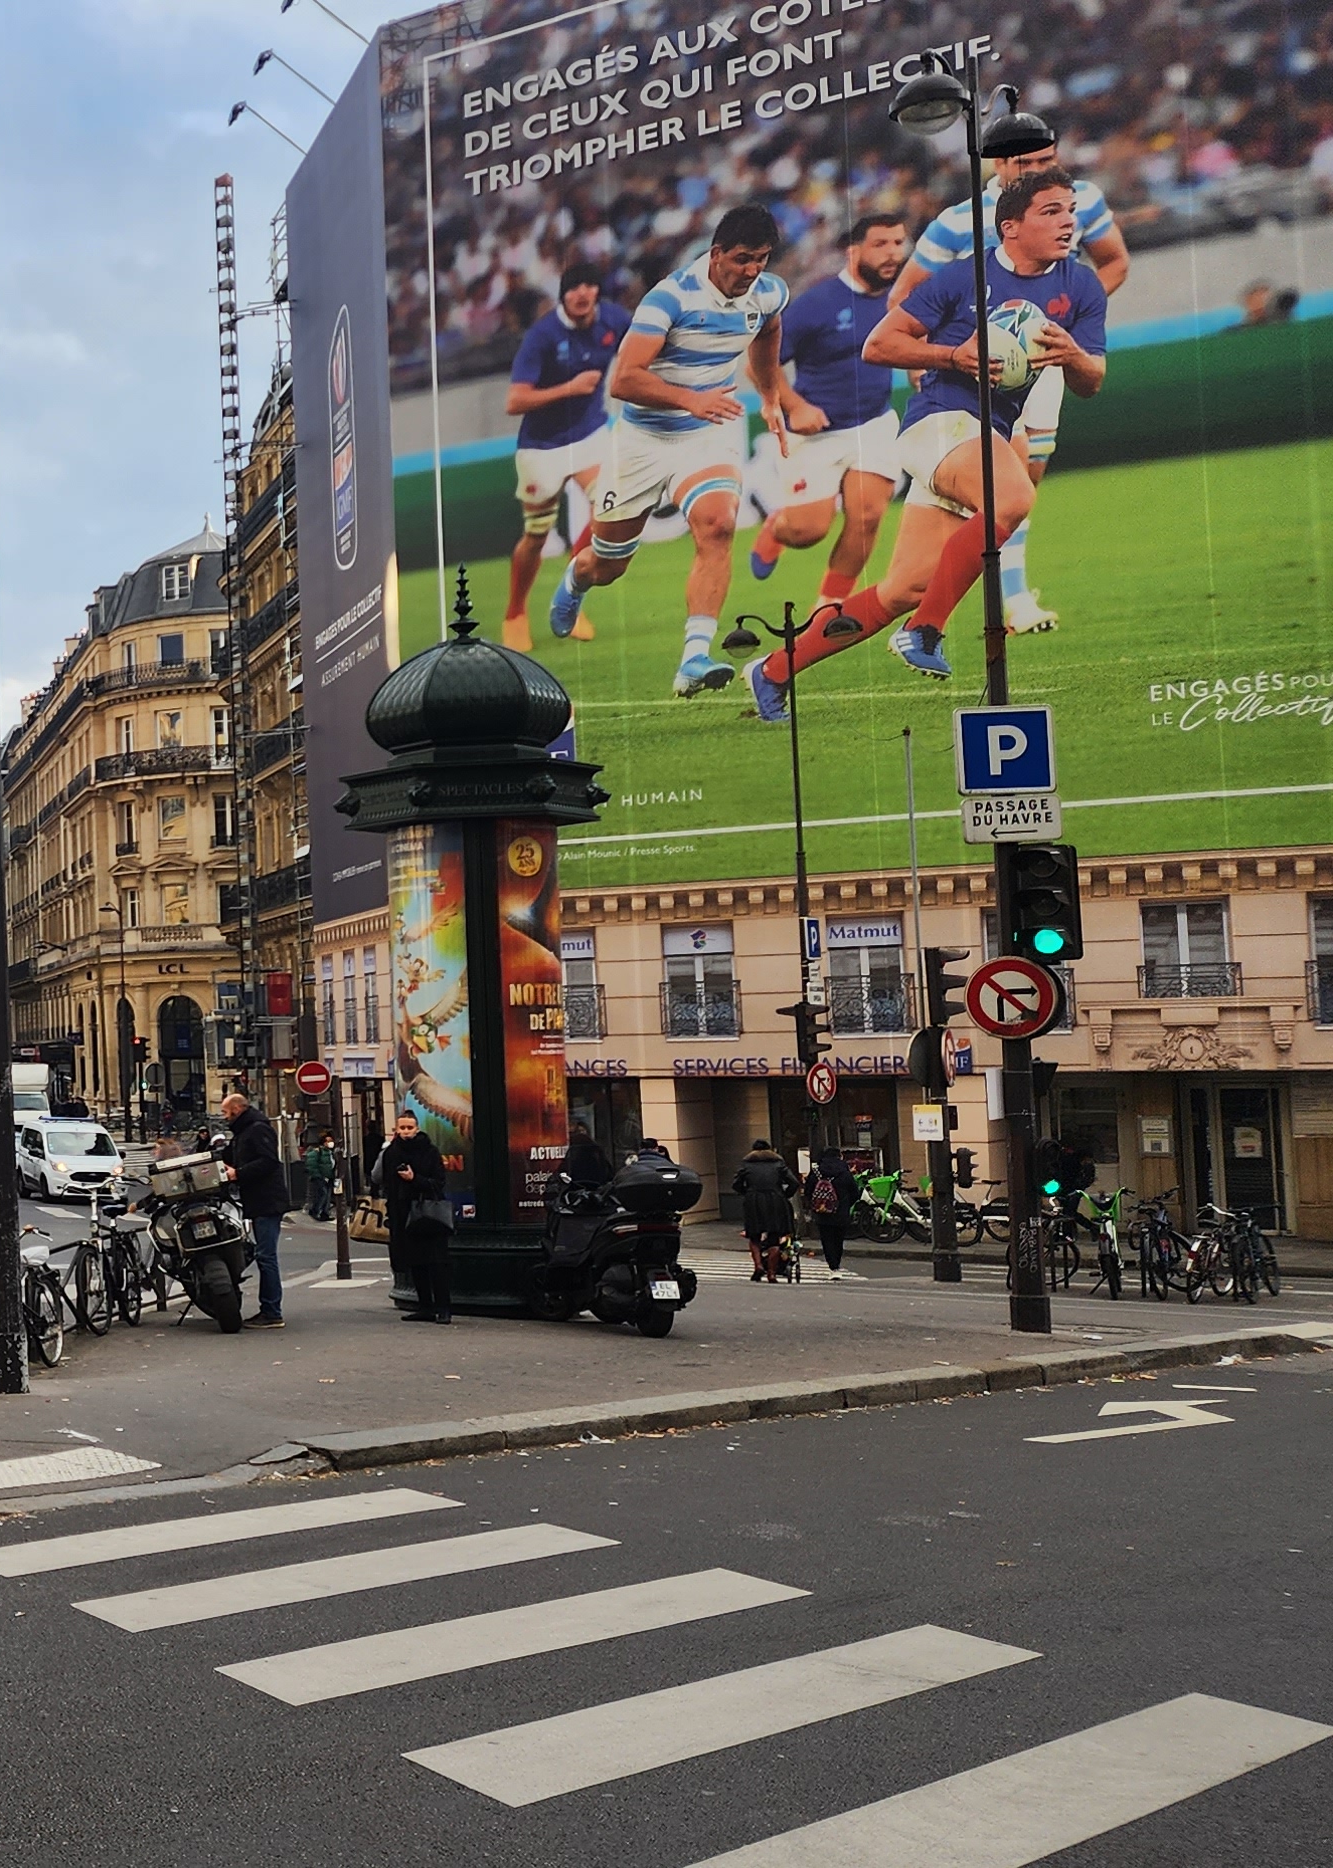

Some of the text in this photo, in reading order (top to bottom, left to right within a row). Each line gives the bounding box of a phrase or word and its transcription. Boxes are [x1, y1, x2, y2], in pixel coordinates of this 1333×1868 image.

[462, 45, 640, 119] ENGAGÉS
[648, 16, 738, 67] AUX
[464, 29, 842, 158] DE CEUX QUI FONT
[464, 116, 686, 196] TRIOMPHER
[697, 103, 743, 136] LE
[602, 490, 618, 512] 6
[1150, 671, 1284, 702] ENGAGÉS
[1152, 712, 1173, 726] LE
[987, 724, 1028, 776] P
[438, 782, 524, 797] SPECTACLES
[621, 788, 703, 807] HUMAIN
[974, 798, 1050, 814] PASSAGE
[972, 811, 1054, 828] DU HAVRE
[515, 843, 535, 860] 25
[563, 851, 586, 861] Alain
[588, 849, 622, 860] Mounic
[630, 846, 661, 857] Presse
[663, 844, 697, 856] Sports.
[518, 858, 536, 869] ANS
[809, 926, 819, 950] P
[828, 924, 900, 940] Matmut
[561, 938, 592, 950] mut
[158, 963, 190, 975] LCL
[530, 1013, 545, 1030] DE
[564, 1060, 628, 1077] ANCES
[673, 1056, 908, 1076] SERVICES FIANCIER
